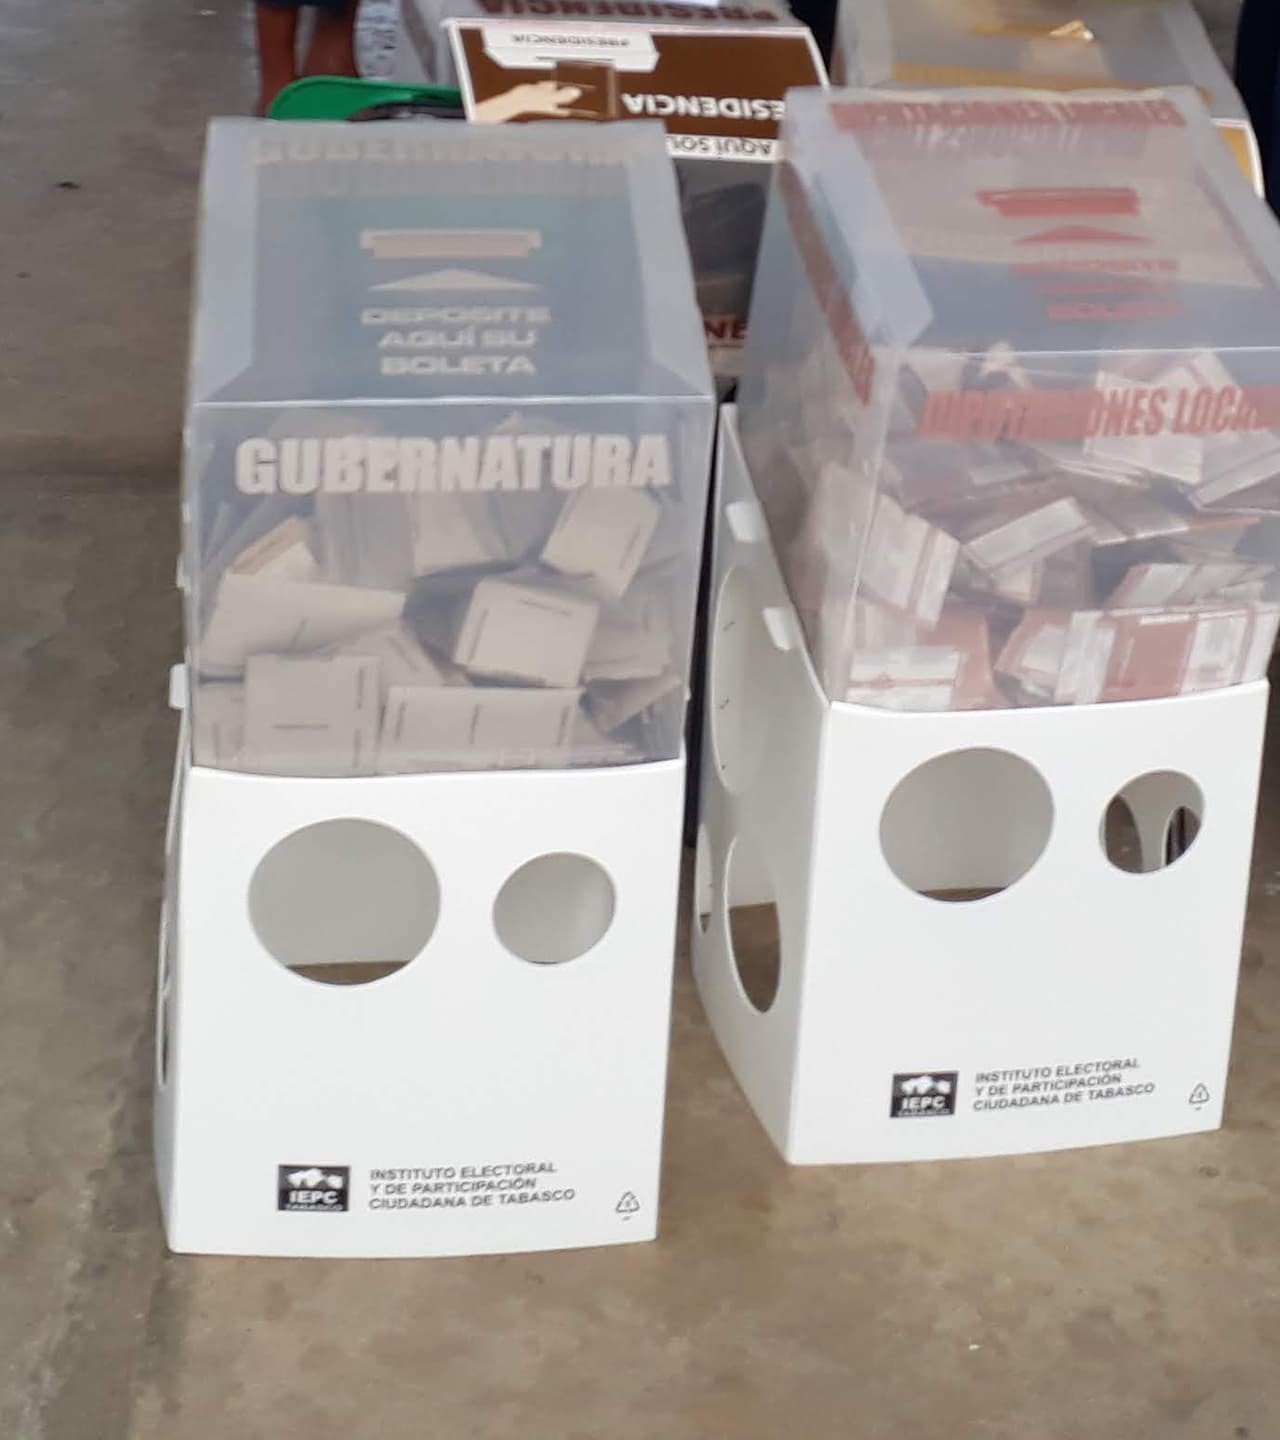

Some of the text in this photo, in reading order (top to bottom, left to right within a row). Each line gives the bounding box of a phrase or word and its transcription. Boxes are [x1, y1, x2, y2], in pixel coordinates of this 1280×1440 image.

[359, 306, 553, 326] DEPOSITE
[376, 328, 538, 350] AQUÍ SU
[379, 354, 539, 377] BOLETA
[234, 433, 673, 496] GUBERNATURA
[974, 1057, 1141, 1083] INSTITUTO ELECTORAL
[974, 1071, 1122, 1097] Y DE PARTICIPACIÓN
[901, 1095, 946, 1109] IEPC
[972, 1082, 1156, 1112] CIUDADANA DE TABASCO
[369, 1162, 558, 1181] INSTITUTO ELECTORAL
[370, 1175, 537, 1196] Y DE PARTICIPACIÓN
[289, 1190, 339, 1204] IEPC
[368, 1188, 576, 1210] CIUDADANA DE TABASCO
